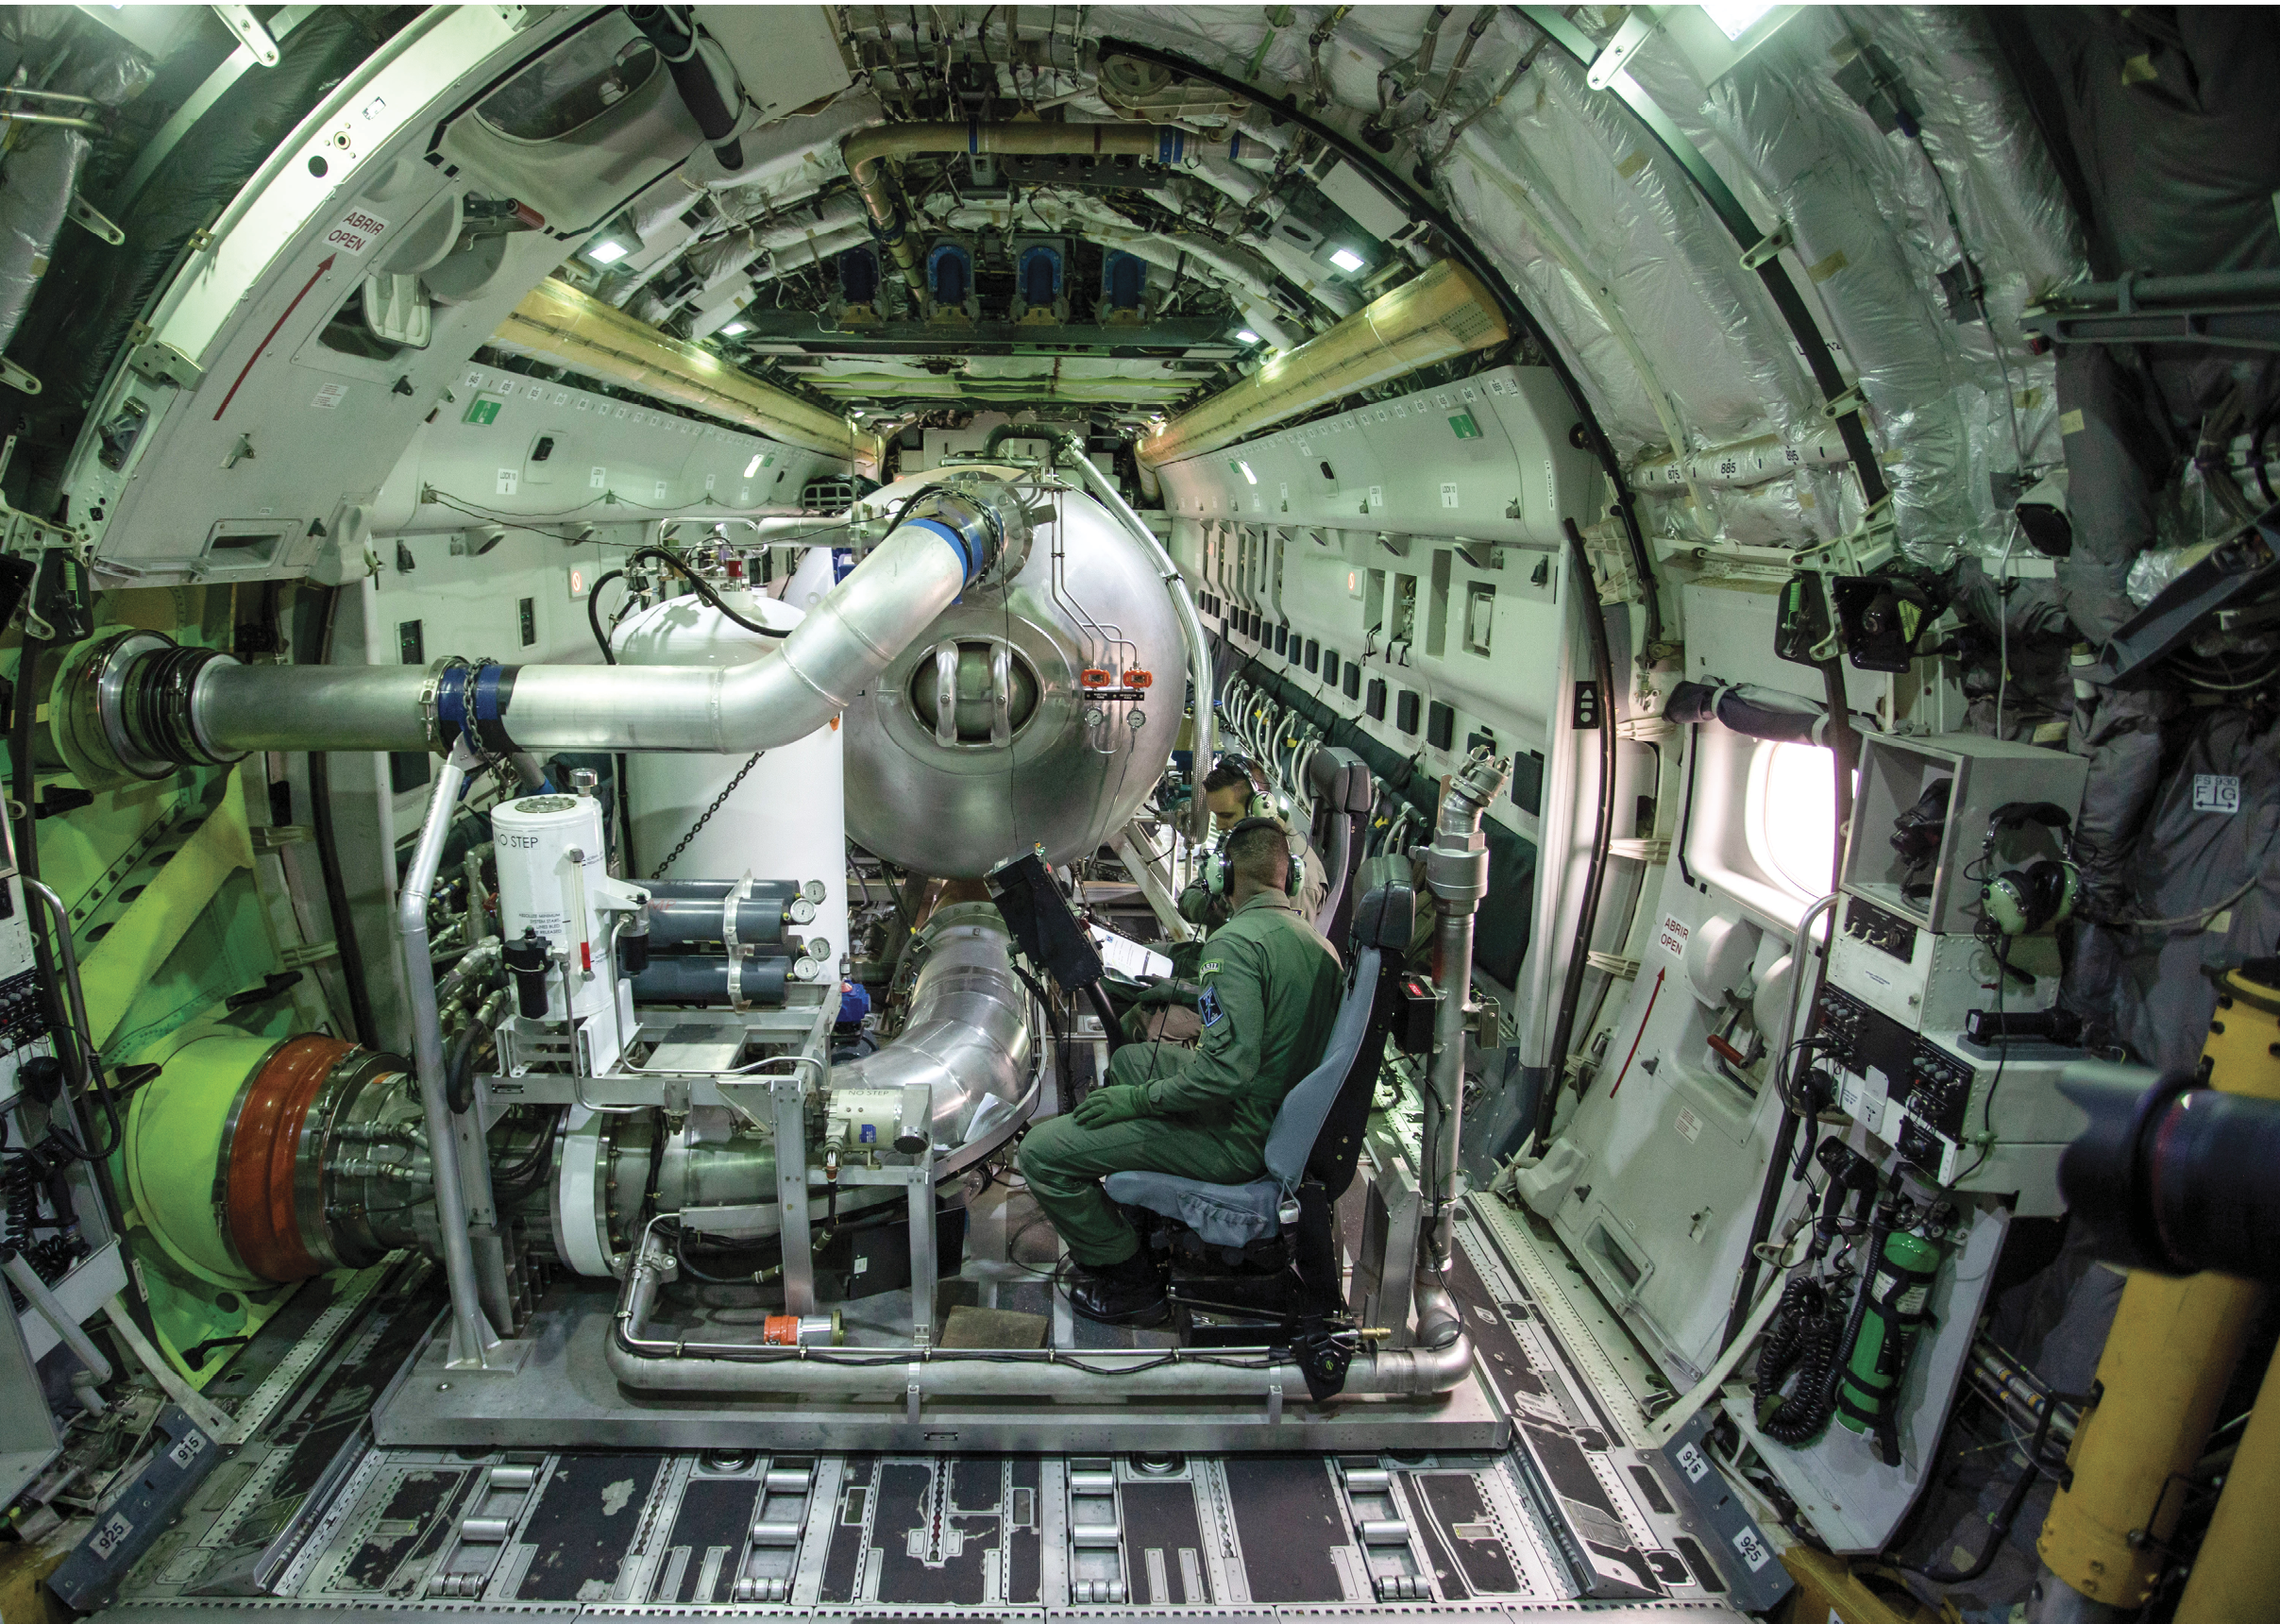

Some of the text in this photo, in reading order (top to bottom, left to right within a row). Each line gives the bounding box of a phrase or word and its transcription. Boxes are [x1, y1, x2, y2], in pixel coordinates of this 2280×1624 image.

[343, 211, 385, 236] ABRIR
[328, 229, 366, 251] OPEN
[1785, 449, 1799, 462] 895
[1667, 469, 1680, 480] 875
[1720, 462, 1736, 474] 885
[1443, 485, 1452, 494] LOCK
[2195, 775, 2238, 787] FS 930
[2196, 786, 2237, 801] F G
[495, 833, 539, 849] NO STEP
[1664, 917, 1689, 941] ABRIR
[1660, 933, 1683, 956] OPEN
[177, 1435, 199, 1461] 915
[1682, 1450, 1701, 1474] 915
[99, 1521, 125, 1549] 925
[1740, 1536, 1762, 1563] 925
